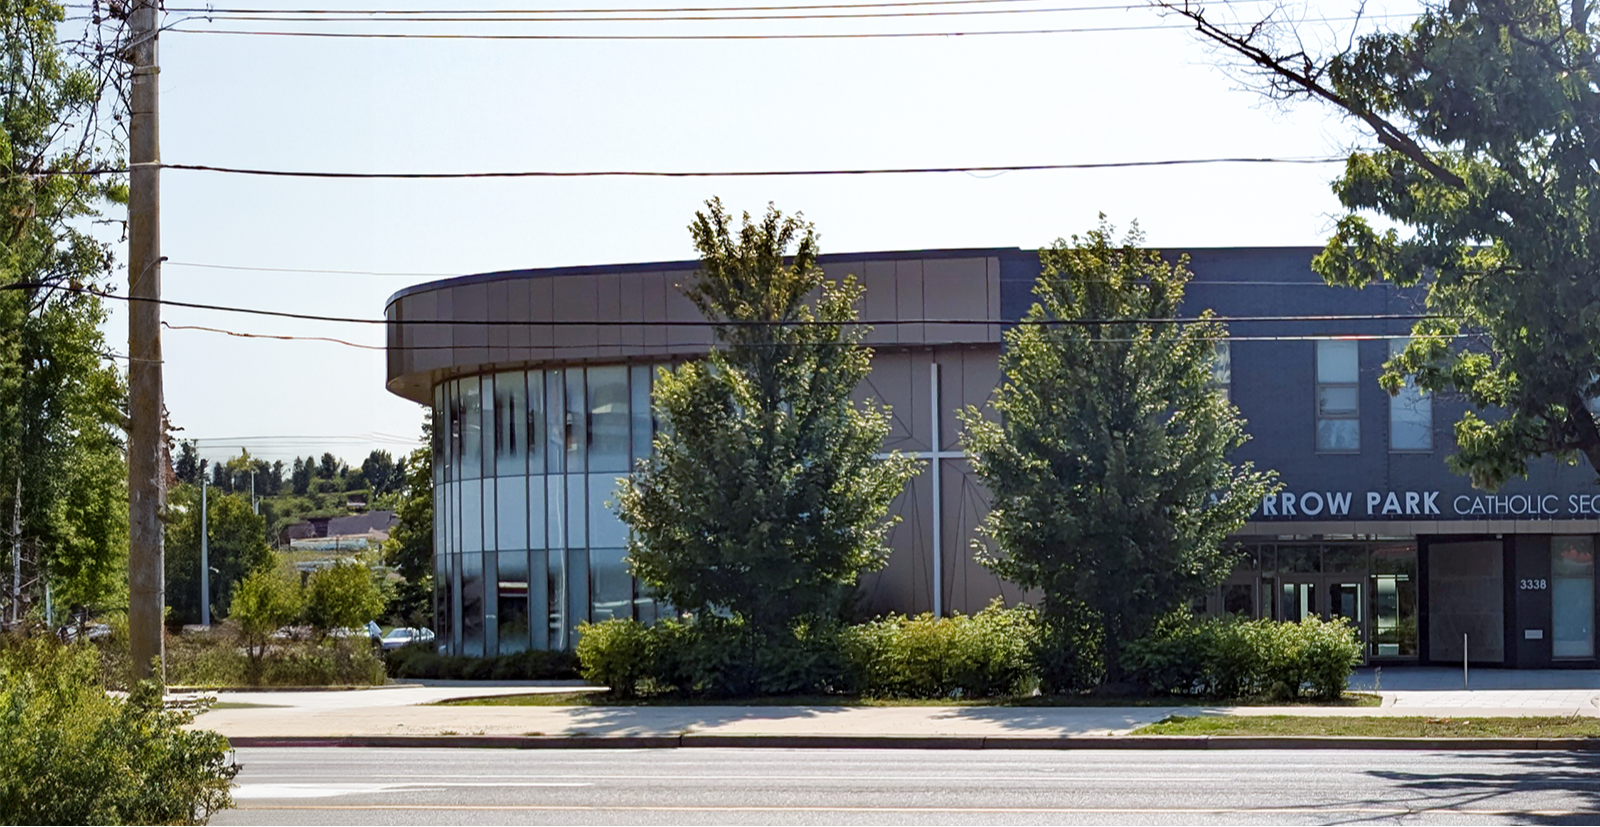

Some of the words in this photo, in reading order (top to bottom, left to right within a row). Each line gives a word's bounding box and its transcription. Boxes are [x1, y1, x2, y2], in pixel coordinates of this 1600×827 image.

[1210, 491, 1352, 516] RROW
[1366, 491, 1441, 516] PARK
[1453, 494, 1559, 515] CATHOLIC
[1520, 579, 1547, 590] 3338
